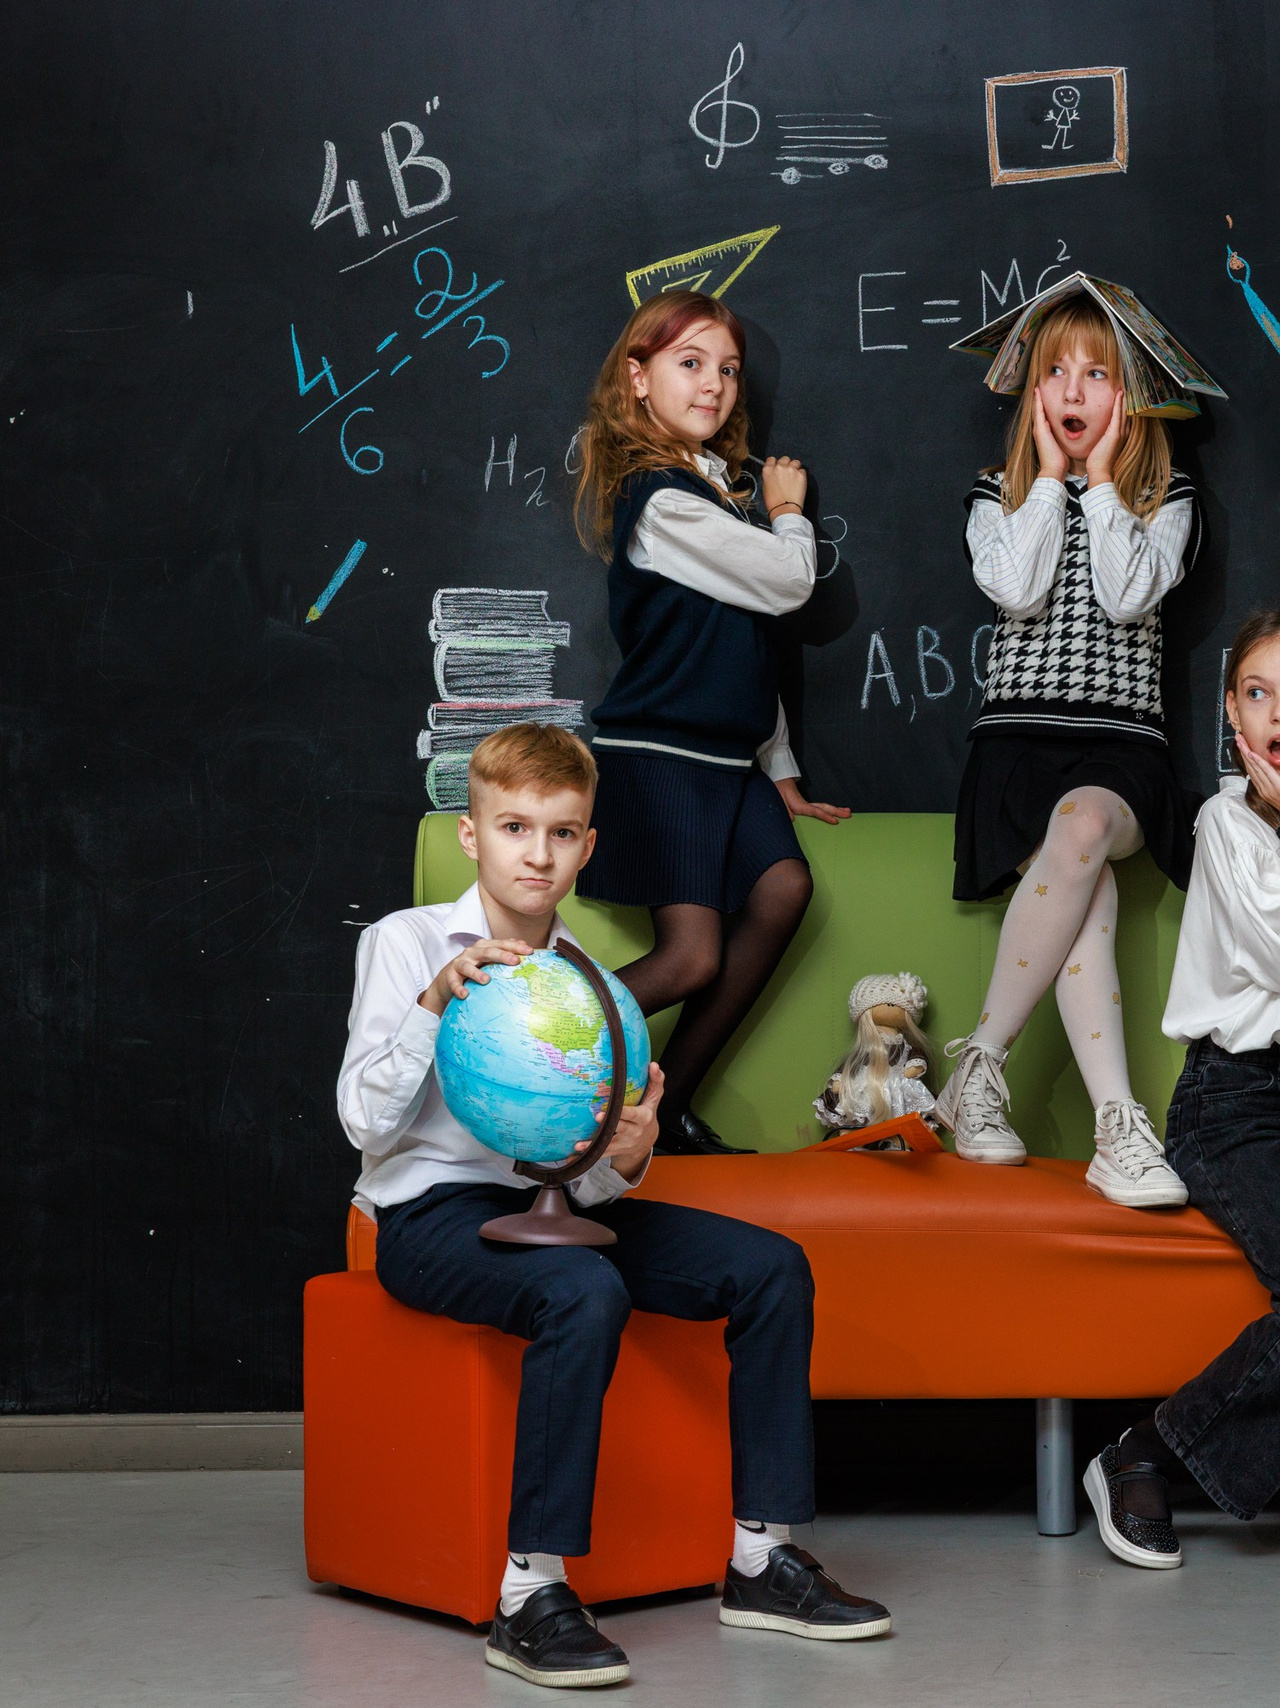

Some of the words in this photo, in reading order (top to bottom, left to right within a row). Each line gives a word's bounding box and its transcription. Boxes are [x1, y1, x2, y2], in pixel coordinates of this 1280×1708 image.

[413, 246, 478, 319] 2
[859, 271, 908, 351] E
[291, 323, 340, 397] 4
[463, 315, 510, 379] 3
[340, 406, 384, 475] 6
